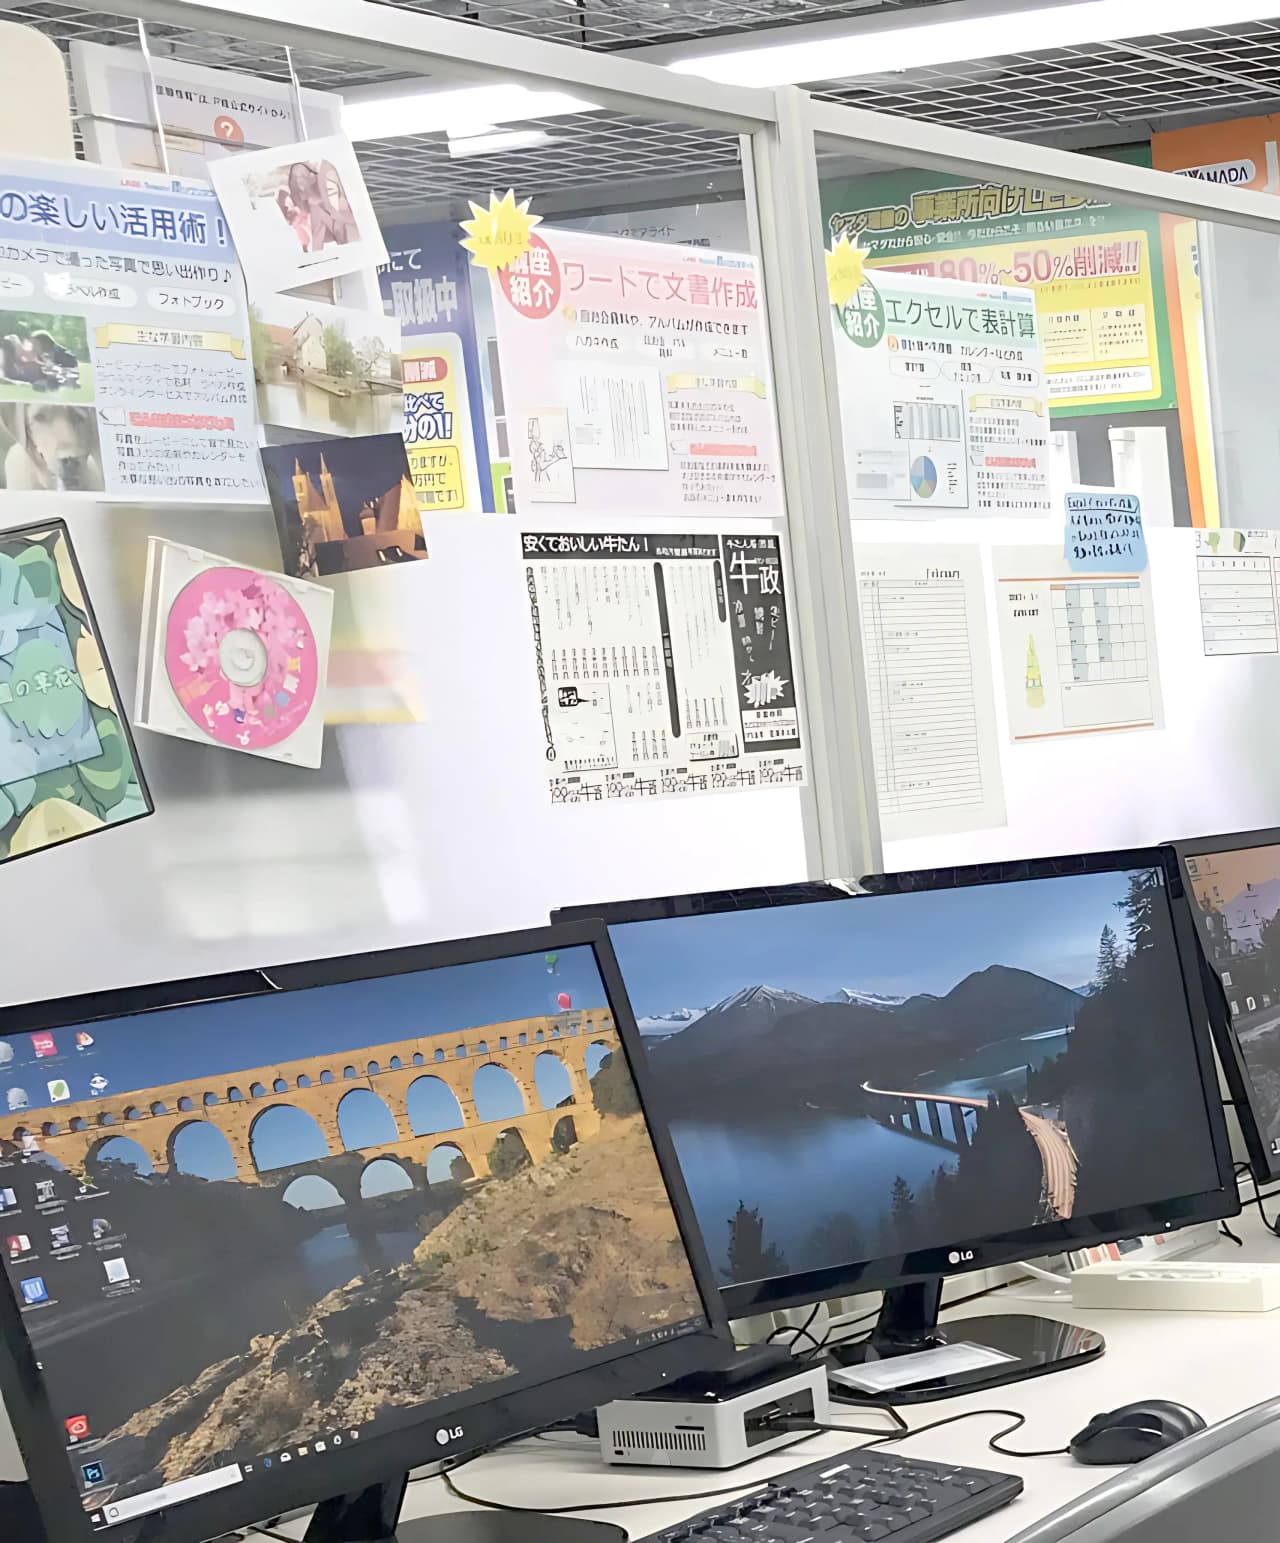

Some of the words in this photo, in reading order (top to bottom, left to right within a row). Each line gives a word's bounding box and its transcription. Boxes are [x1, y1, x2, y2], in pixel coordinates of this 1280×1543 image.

[509, 276, 554, 310] 紹介
[563, 262, 758, 309] ワードで文書作成
[844, 310, 881, 340] 紹介
[885, 298, 1036, 338] エクセルで表計算
